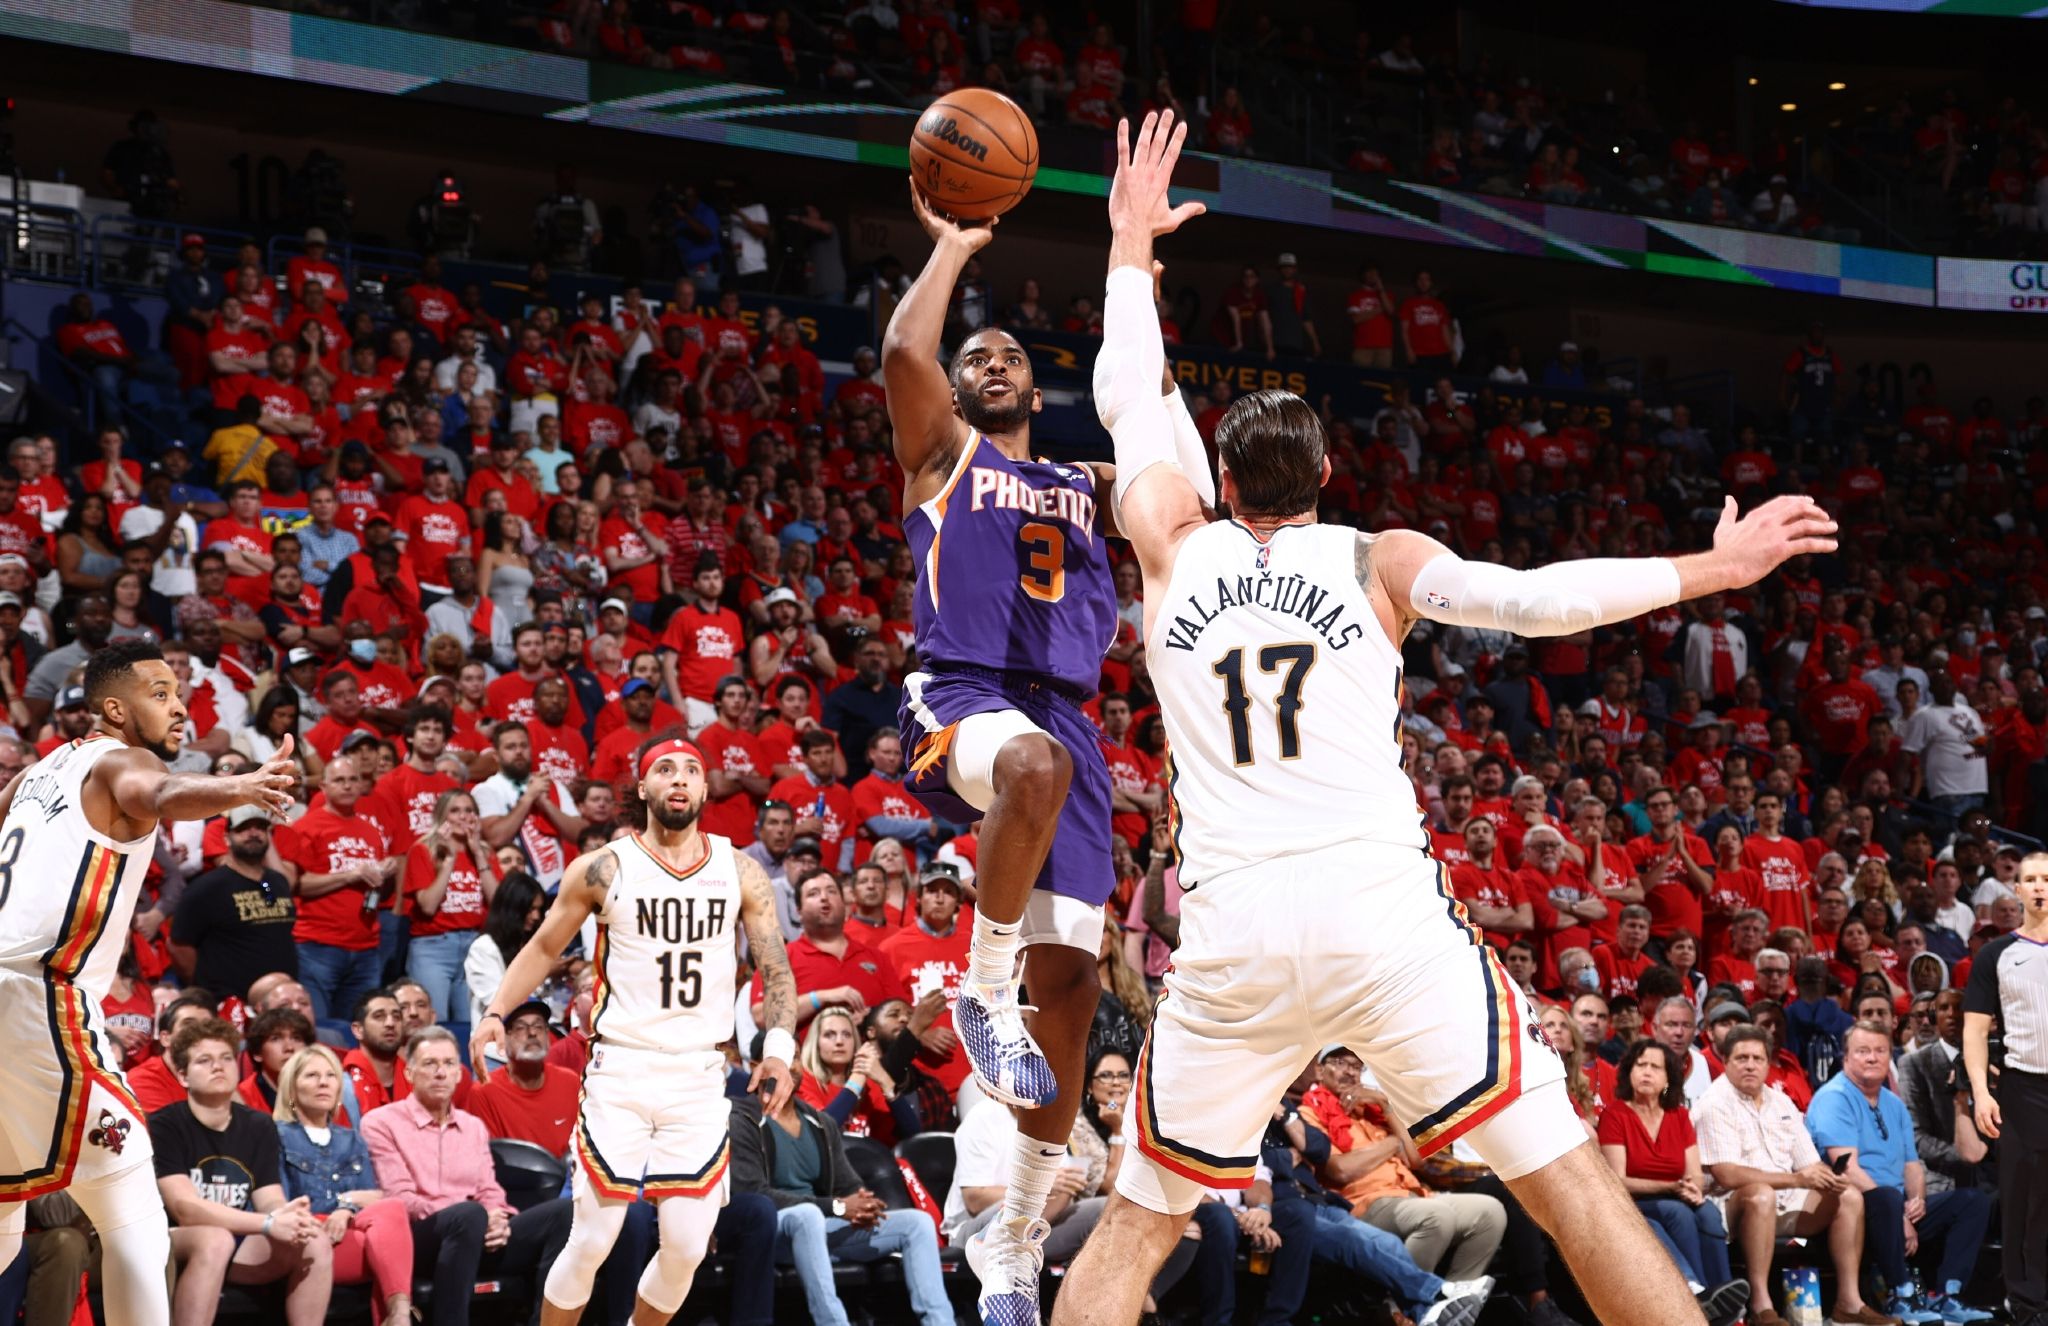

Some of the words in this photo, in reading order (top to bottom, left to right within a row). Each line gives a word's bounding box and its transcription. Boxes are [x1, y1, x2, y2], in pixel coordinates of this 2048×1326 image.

[1019, 522, 1065, 604] 3
[1165, 571, 1363, 653] VALANČIŪNAS
[1211, 641, 1319, 768] 17
[8, 773, 69, 824] cCOLLUM
[697, 878, 727, 888] ibotta
[635, 897, 728, 944] NOLA
[655, 950, 704, 1010] 15
[211, 1174, 227, 1184] THE
